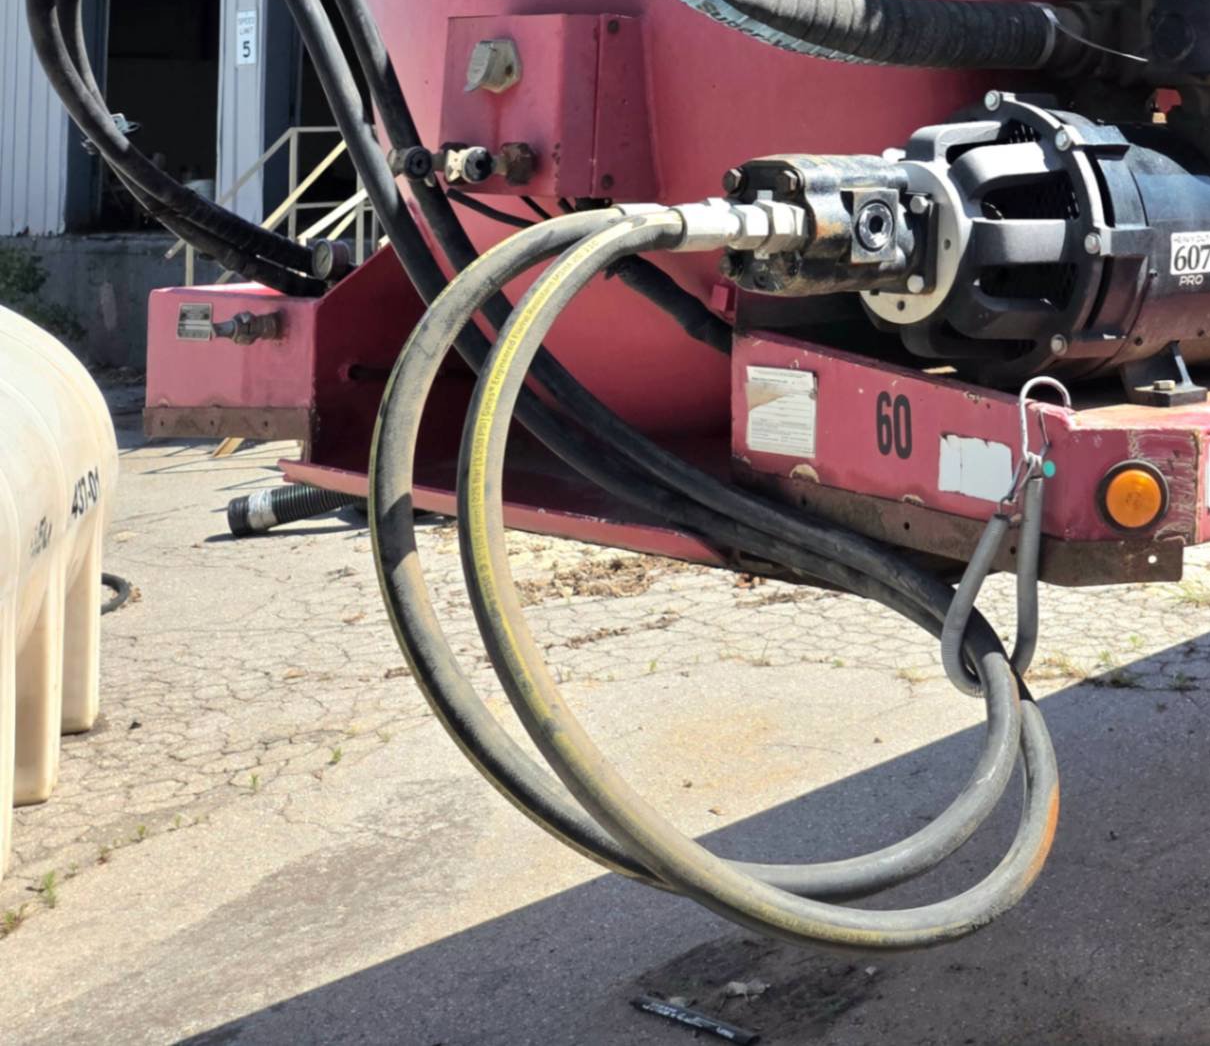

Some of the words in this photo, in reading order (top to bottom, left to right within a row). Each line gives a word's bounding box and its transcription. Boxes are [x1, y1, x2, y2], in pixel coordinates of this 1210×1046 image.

[243, 40, 251, 58] 5
[1179, 274, 1203, 287] PRO
[491, 338, 517, 385] Engineered
[876, 391, 912, 460] 60
